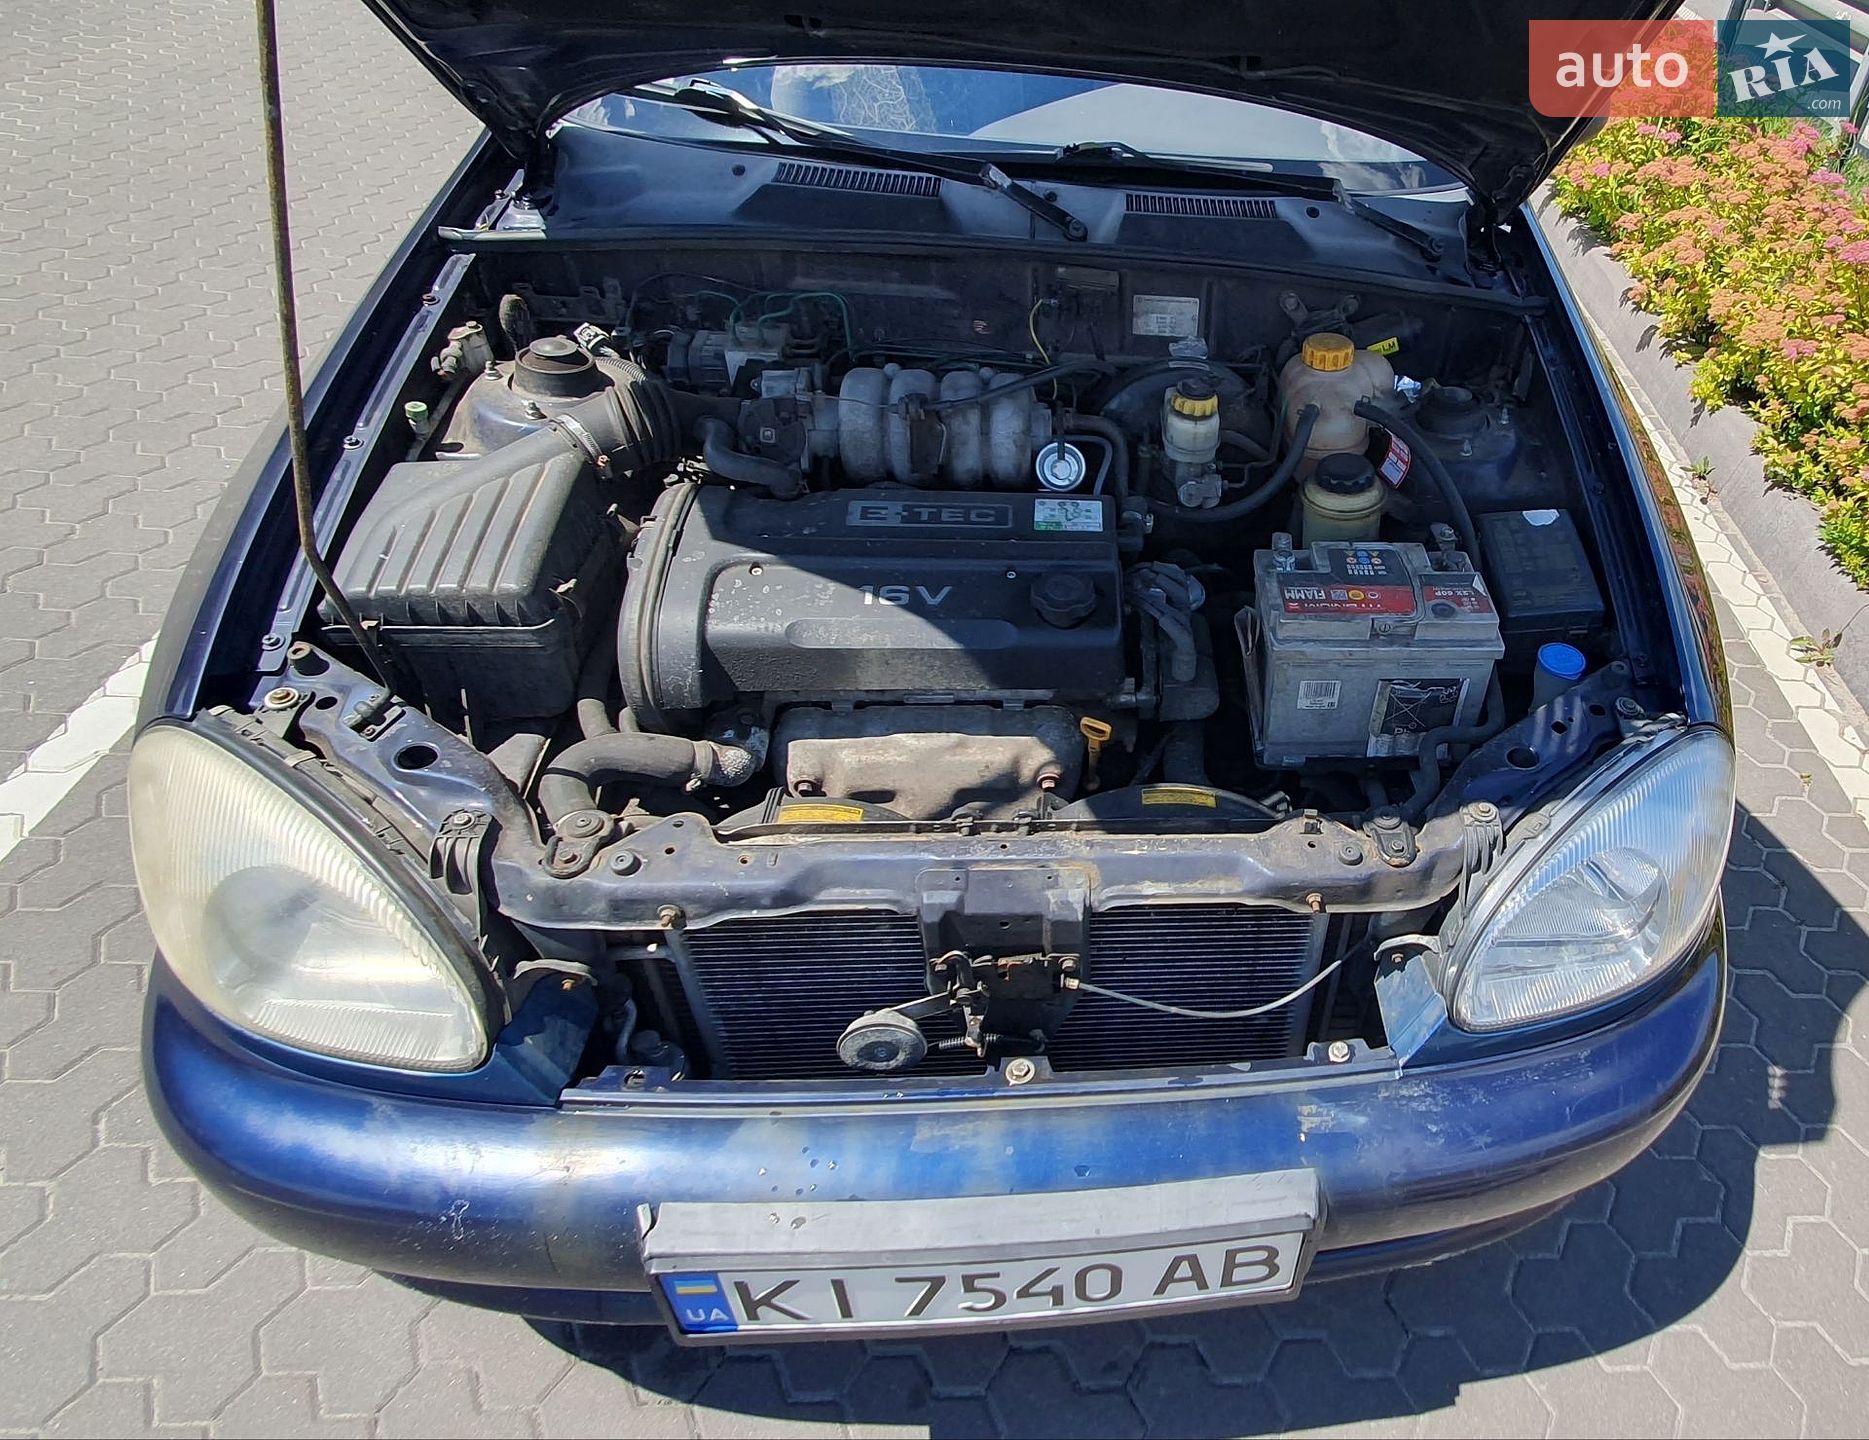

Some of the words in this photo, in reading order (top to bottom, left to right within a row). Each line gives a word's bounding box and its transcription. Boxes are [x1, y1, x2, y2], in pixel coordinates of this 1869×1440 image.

[859, 585, 952, 605] 16V
[1284, 588, 1326, 600] FIAMM
[733, 1278, 854, 1321] KI
[894, 1263, 1124, 1318] 7540
[1153, 1245, 1281, 1296] AB
[686, 1307, 729, 1322] UA
